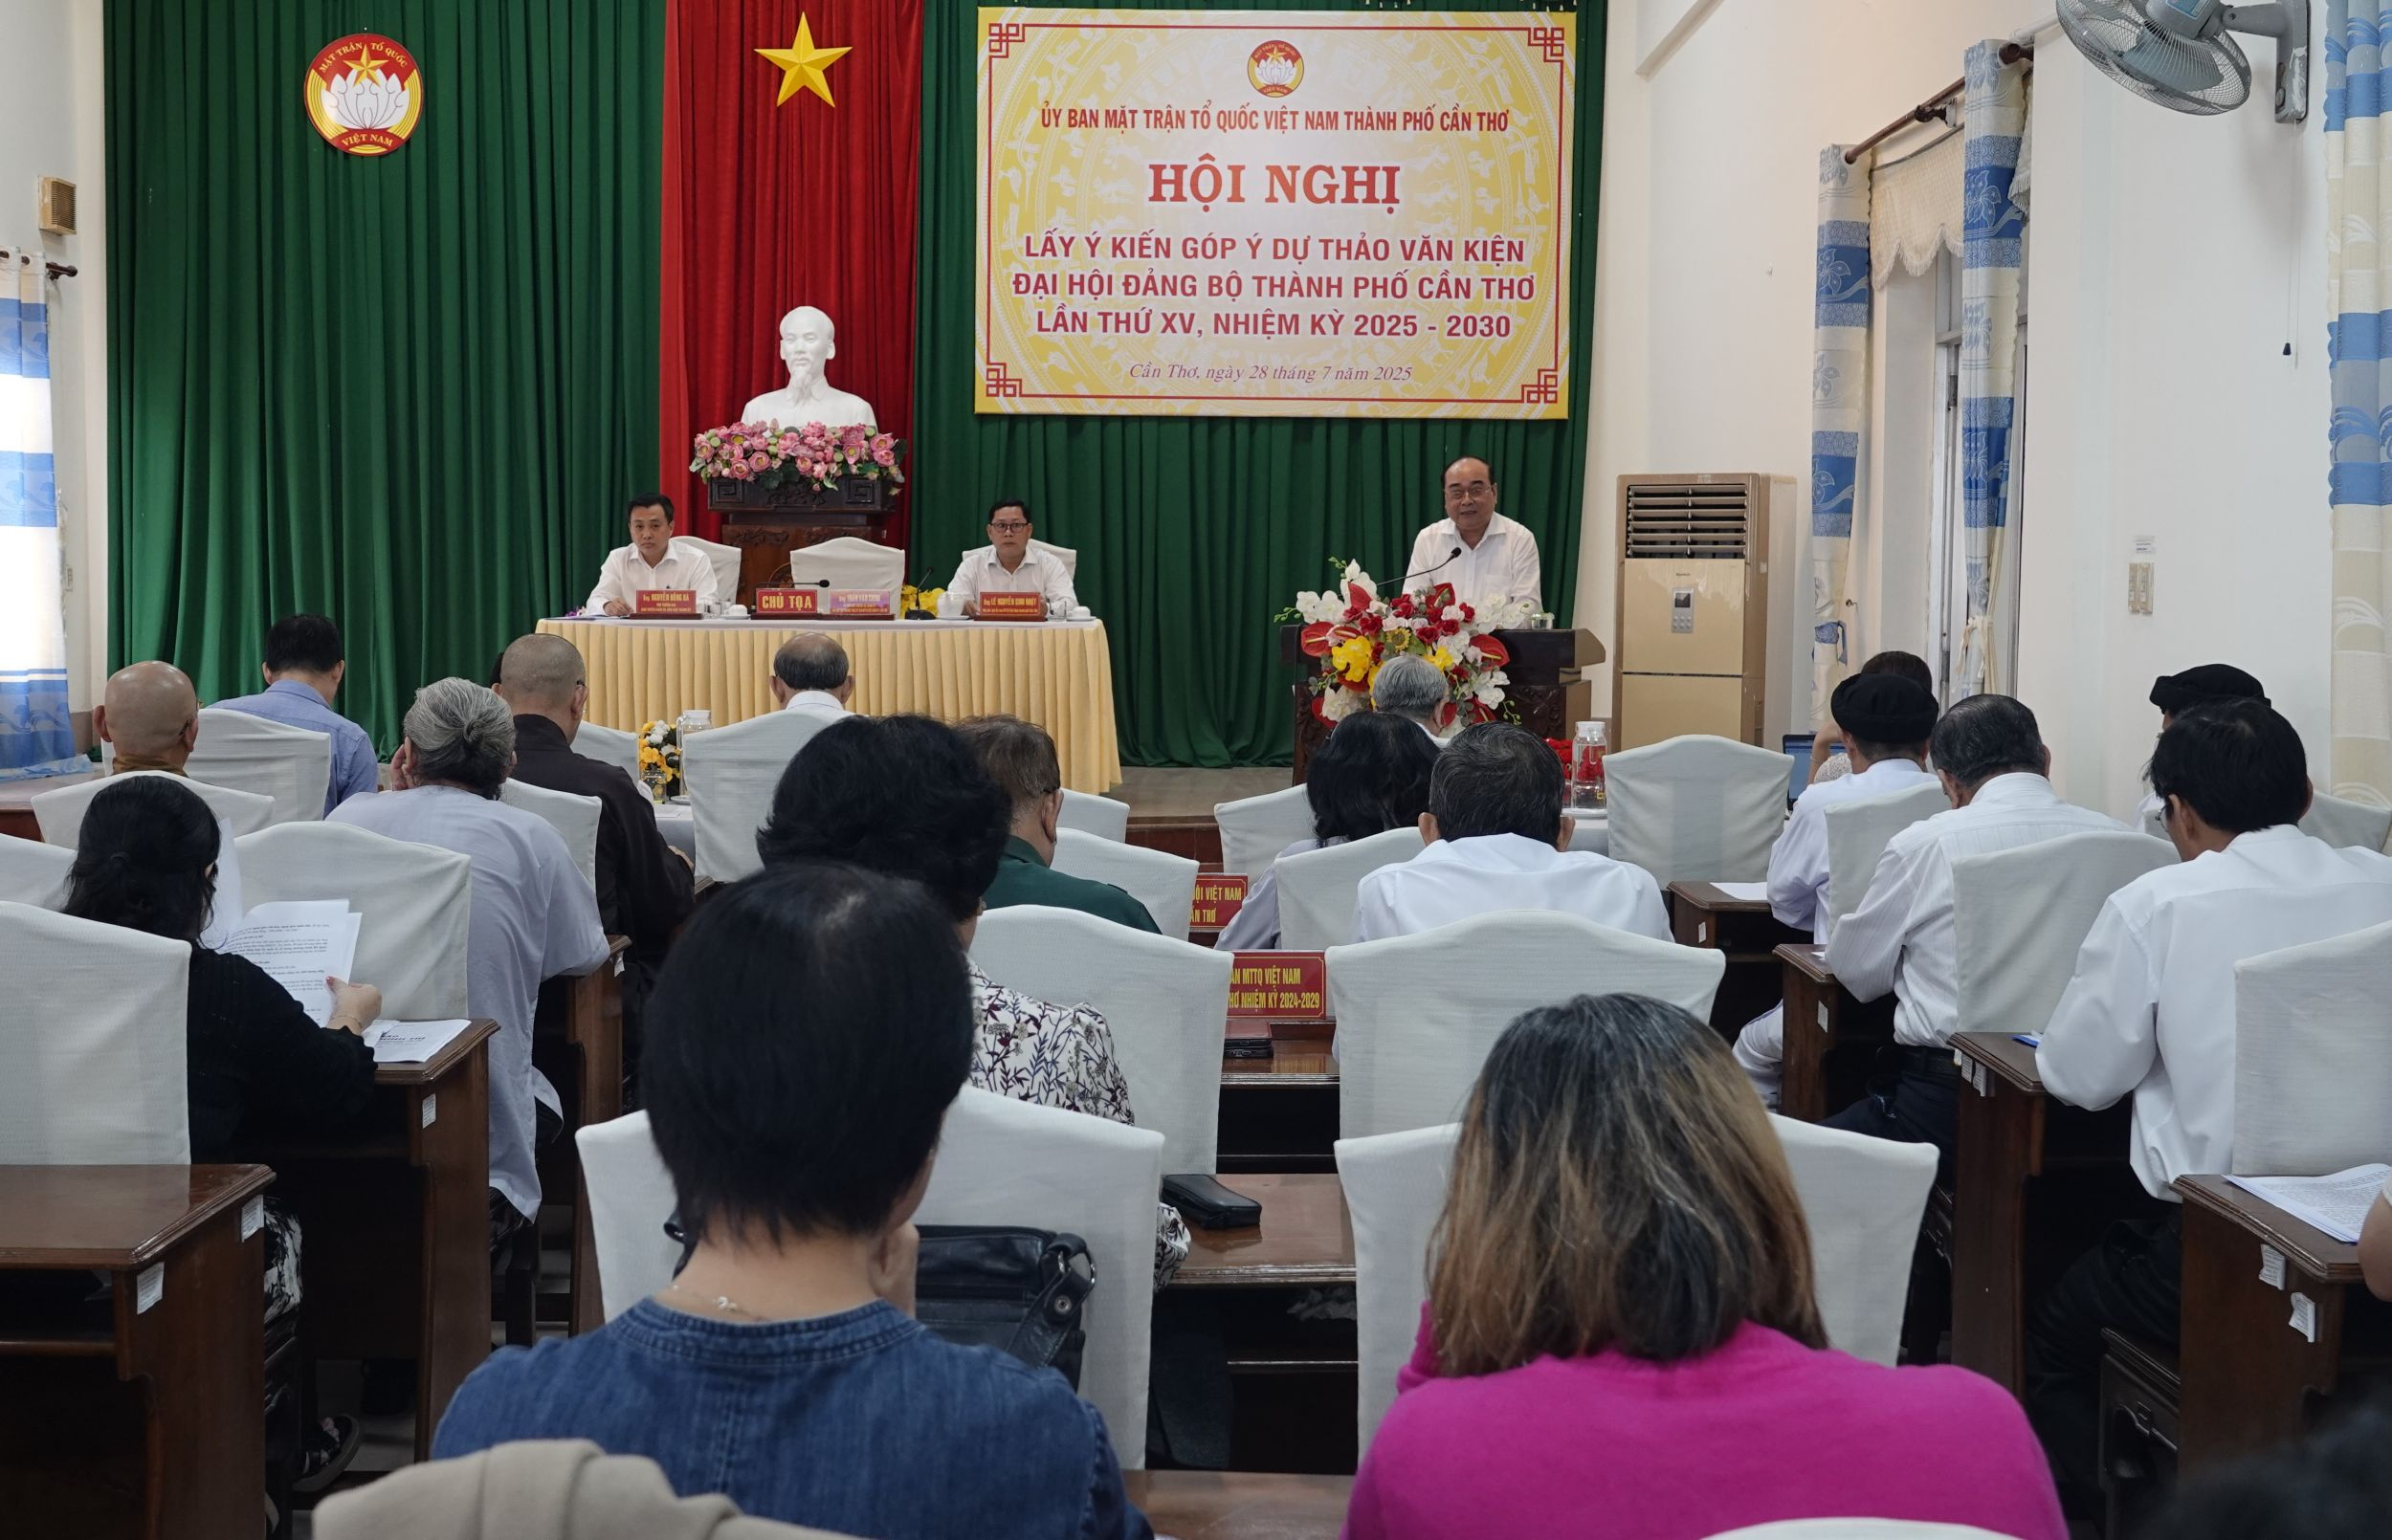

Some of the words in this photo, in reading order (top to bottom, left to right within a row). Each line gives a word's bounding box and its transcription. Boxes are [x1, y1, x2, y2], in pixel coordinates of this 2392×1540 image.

[1041, 100, 1062, 128] ỦY
[1068, 108, 1098, 128] BAN
[1104, 105, 1138, 134] MẶT
[1143, 104, 1185, 134] TRẬN
[1190, 99, 1211, 129] TỔ
[1216, 102, 1258, 134] QUỐC
[1264, 105, 1299, 134] VIỆT
[1304, 110, 1339, 131] NAM
[1343, 105, 1397, 131] THÀNH
[1403, 103, 1436, 131] PHỐ
[1440, 103, 1472, 131] CẦN
[1476, 109, 1510, 132] THƠ
[342, 133, 367, 146] VIỆT
[369, 134, 393, 147] NAM
[1148, 152, 1246, 212] HỘI
[1265, 165, 1401, 214] NGHỊ
[1025, 228, 1075, 258] LẤY
[1085, 231, 1101, 258] Ý
[1111, 229, 1171, 259] KIẾN
[1182, 231, 1237, 259] GÓP
[1246, 231, 1263, 260] Ý
[1273, 234, 1311, 265] DỰ
[1318, 231, 1389, 261] THẢO
[1400, 234, 1453, 261] VĂN
[1464, 234, 1524, 267] KIỆN
[1012, 273, 1057, 299] ĐẠI
[1068, 269, 1113, 300] HỘI
[1122, 268, 1197, 297] ĐẢNG
[1207, 270, 1243, 302] BỘ
[1251, 271, 1342, 298] THÀNH
[1353, 269, 1408, 298] PHỐ
[1418, 269, 1471, 299] CẦN
[1481, 275, 1535, 300] THƠ
[1037, 302, 1088, 333] LẦN
[1097, 306, 1153, 334] THỨ
[1161, 312, 1203, 338] XV,
[1213, 307, 1299, 340] NHIỆM
[1311, 308, 1345, 336] KỲ
[1354, 314, 1417, 337] 2025
[1447, 315, 1511, 338] 2030
[1129, 361, 1162, 379] Cần
[1206, 365, 1244, 383] ngày
[1249, 364, 1267, 380] 28
[1273, 364, 1316, 384] tháng
[1322, 366, 1332, 381] 7
[1335, 367, 1368, 381] năm
[1373, 365, 1413, 382] 2025
[762, 592, 784, 609] CHỦ
[788, 595, 812, 610] TỌA
[1194, 884, 1204, 904] ỘI
[1206, 884, 1223, 905] VIỆT
[1225, 887, 1242, 901] NAM
[1203, 907, 1217, 923] THƠ
[1229, 967, 1241, 984] AN
[1243, 968, 1263, 986] MTTQ
[1265, 964, 1282, 988] VIỆT
[1282, 967, 1301, 984] NAM
[1229, 989, 1240, 1008] HƠ
[1242, 988, 1266, 1013] NHIỆM
[1268, 989, 1278, 1009] KỲ
[1279, 991, 1320, 1009] 2024-2029
